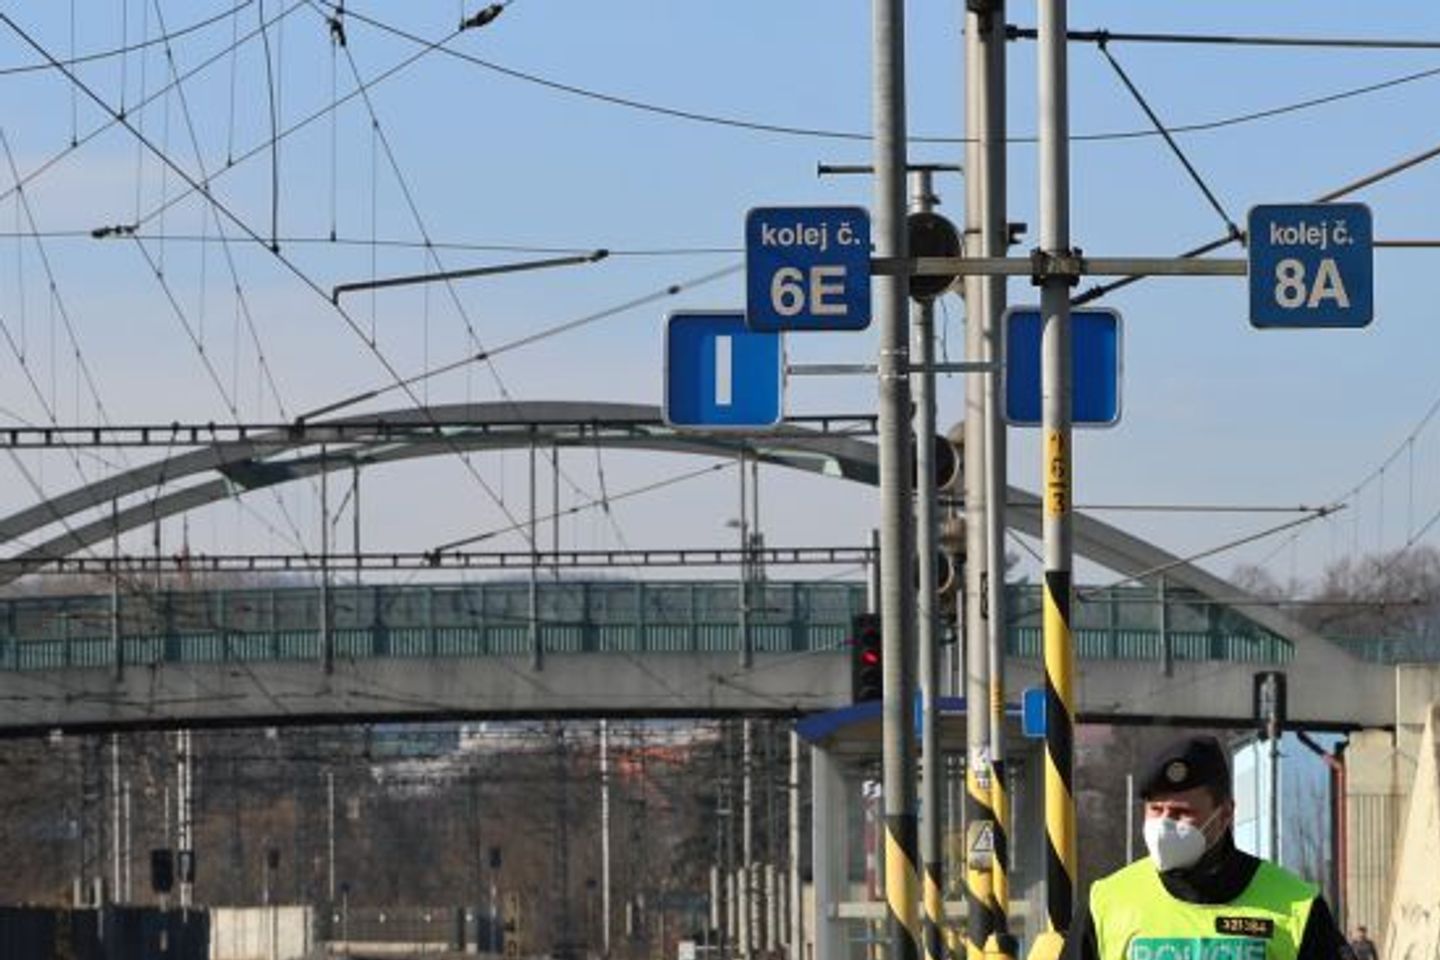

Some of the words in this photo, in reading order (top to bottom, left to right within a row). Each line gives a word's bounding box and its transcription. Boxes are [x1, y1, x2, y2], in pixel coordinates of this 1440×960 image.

[761, 221, 829, 252] kolej
[837, 222, 861, 246] č.
[1269, 220, 1329, 251] kolej
[1332, 220, 1355, 245] č.
[770, 265, 848, 317] 6E
[1274, 257, 1351, 309] 8A
